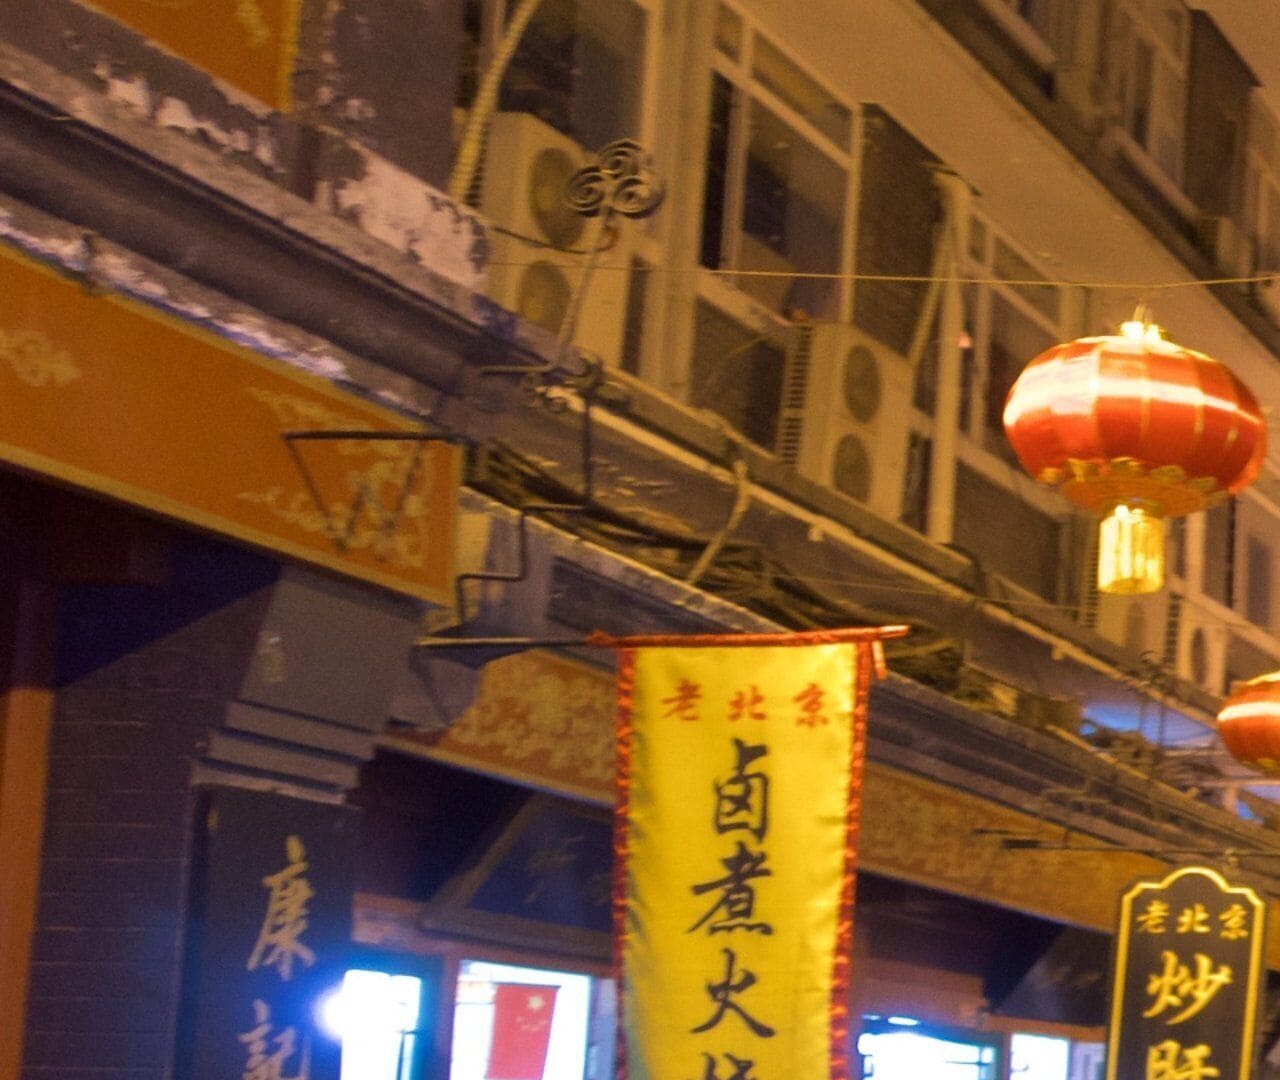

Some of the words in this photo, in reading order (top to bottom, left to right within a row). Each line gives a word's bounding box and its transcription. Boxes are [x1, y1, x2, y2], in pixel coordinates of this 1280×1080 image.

[660, 676, 832, 730] 老北京
[1136, 900, 1252, 941] 老北京
